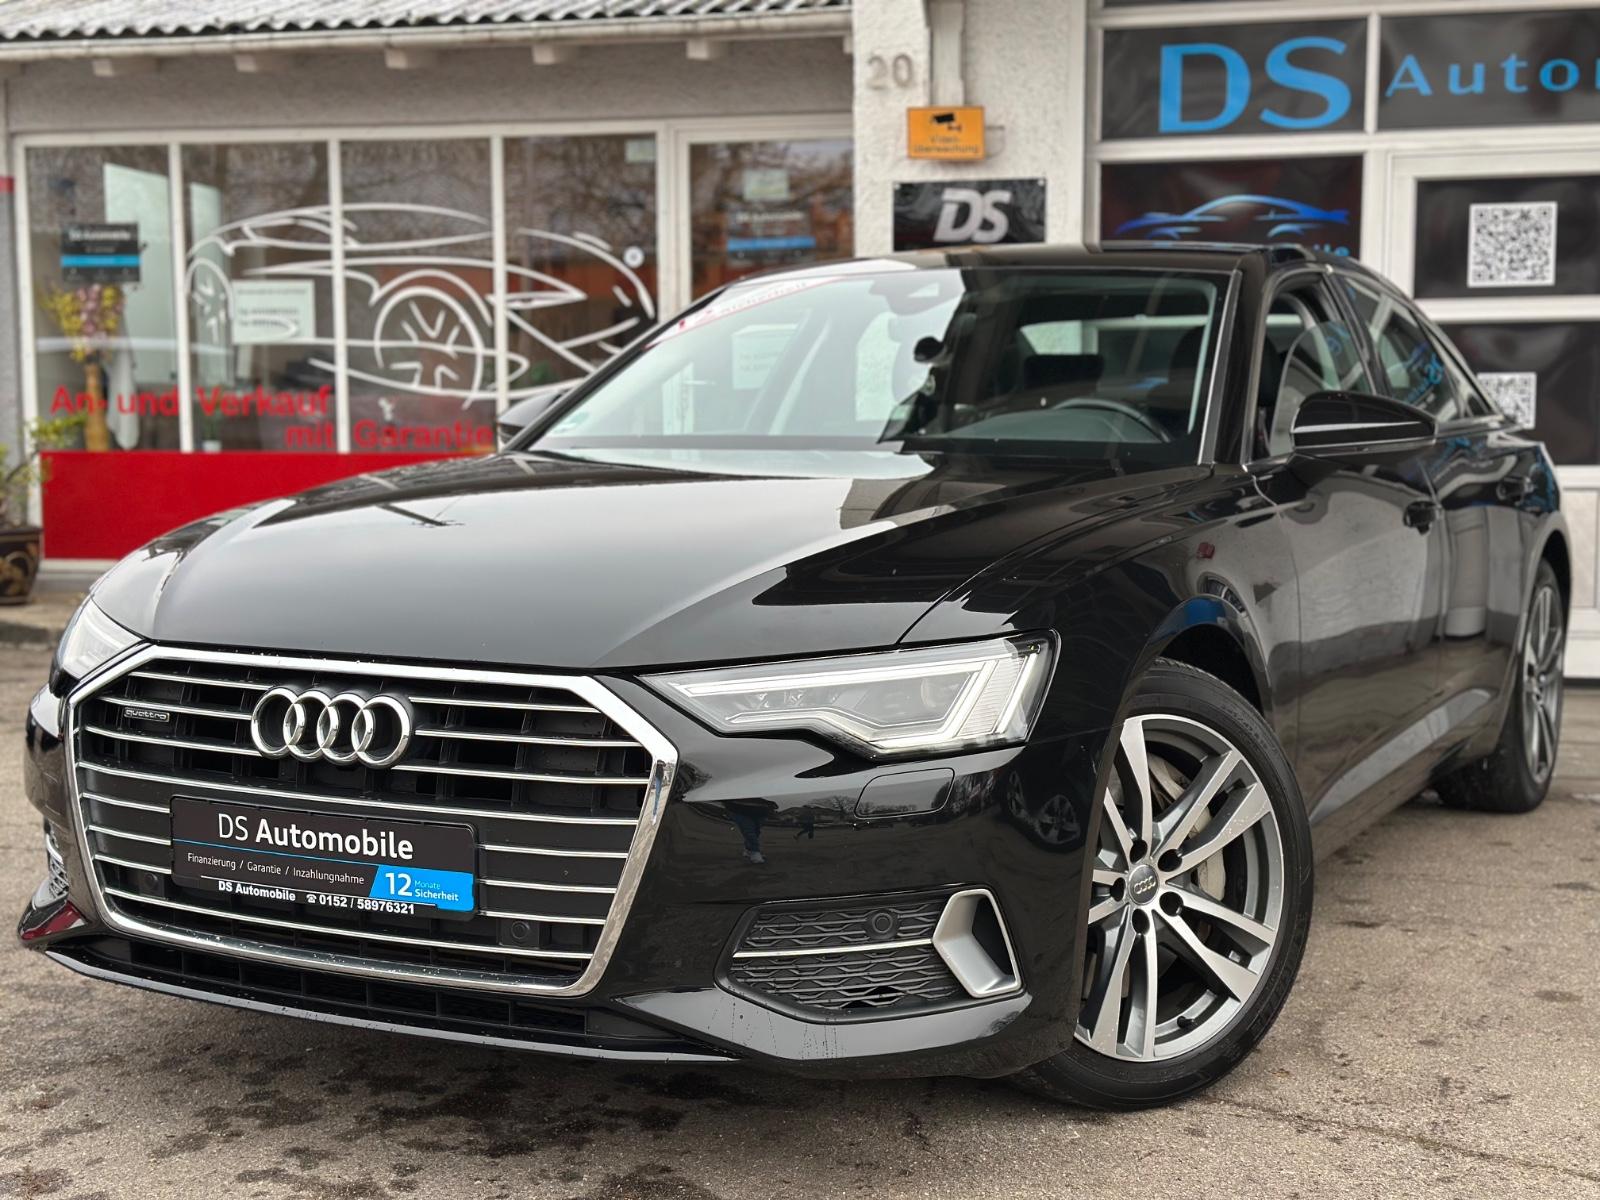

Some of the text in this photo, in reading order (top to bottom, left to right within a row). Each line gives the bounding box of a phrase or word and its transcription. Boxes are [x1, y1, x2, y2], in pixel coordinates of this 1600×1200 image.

[866, 54, 915, 90] 20
[1159, 37, 1600, 134] DS Auto
[933, 188, 1012, 243] DS
[116, 385, 179, 416] und
[196, 384, 332, 416] Verkauf
[286, 418, 494, 448] mit Garantie
[125, 709, 167, 720] quattro
[218, 813, 414, 860] DS Automobile
[187, 852, 236, 871] Finanzierung
[247, 861, 282, 875] Garantie
[293, 867, 365, 885] Inzahlungnahme
[385, 872, 413, 897] 12
[218, 880, 233, 892] DS
[235, 883, 296, 901] Automobile
[318, 893, 348, 907] 0152
[357, 898, 415, 915] 58976321
[414, 880, 441, 890] Monate
[414, 888, 459, 901] Sicherheit
